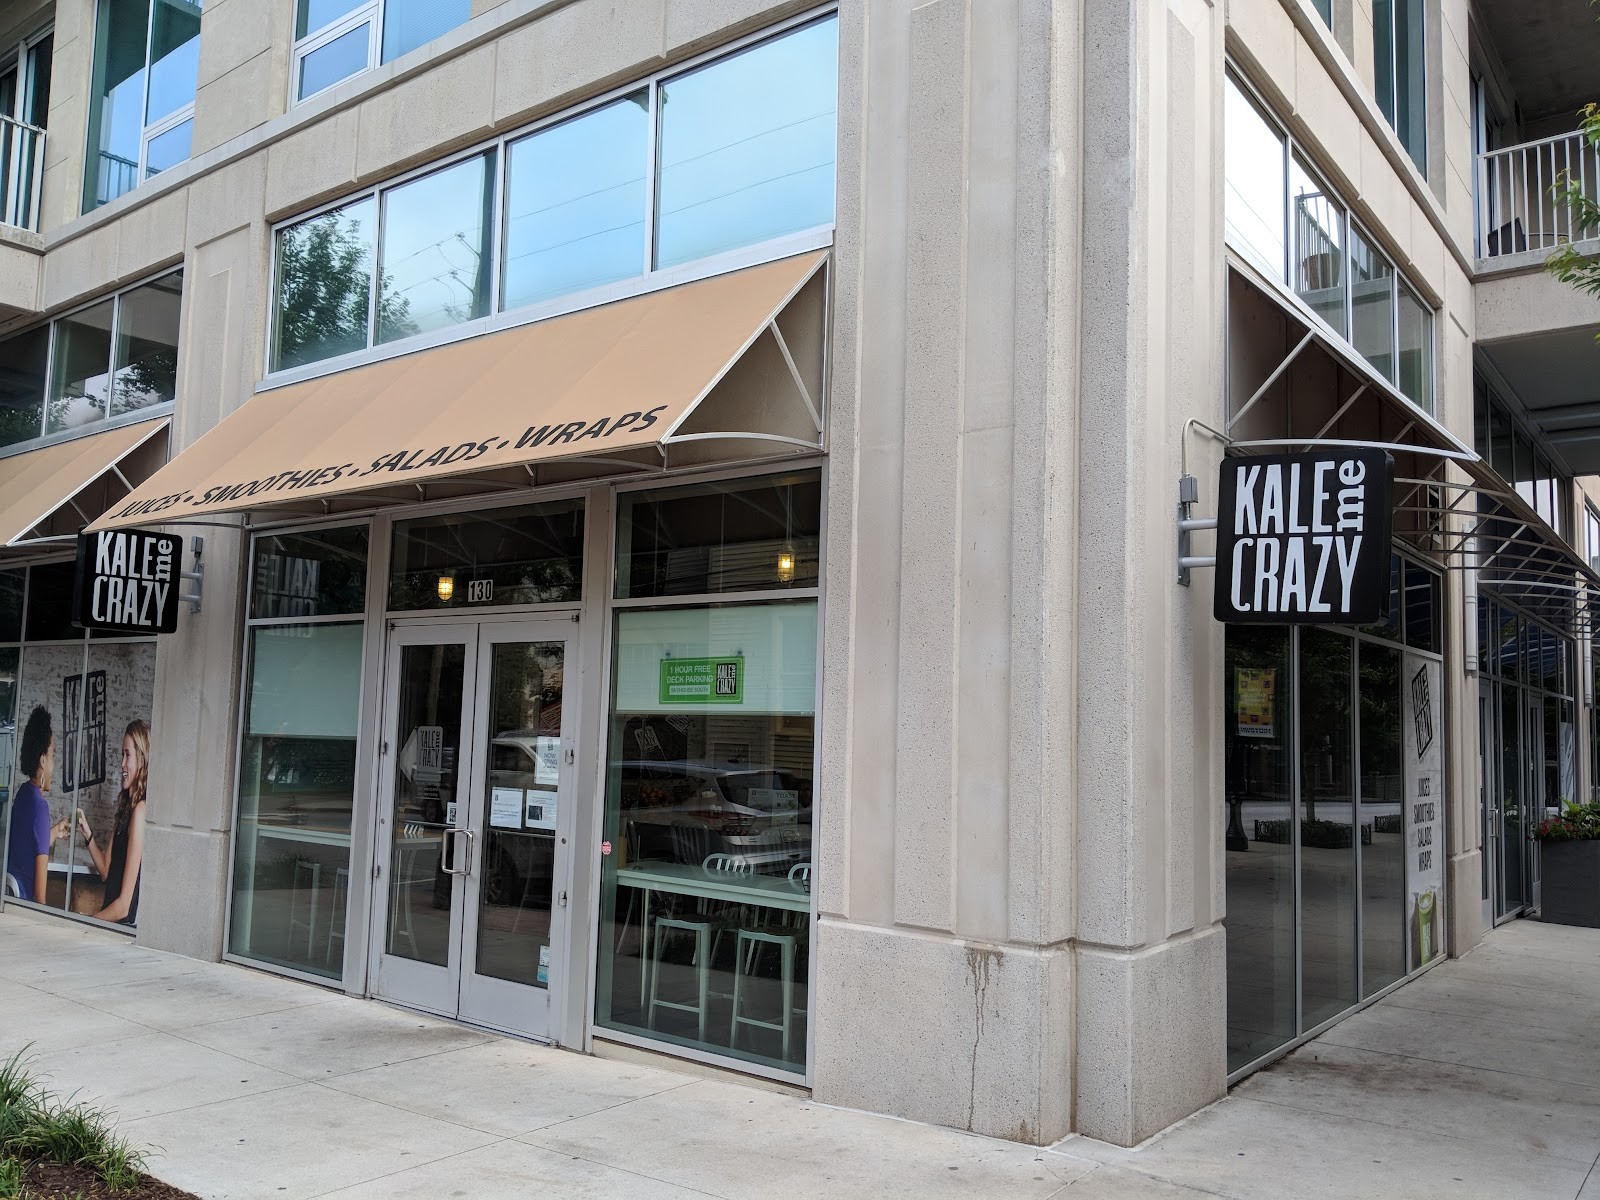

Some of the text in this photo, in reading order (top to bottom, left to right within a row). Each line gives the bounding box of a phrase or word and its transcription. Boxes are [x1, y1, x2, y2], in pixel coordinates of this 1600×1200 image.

[109, 405, 669, 519] JUICES SMOOTHIES SALADS WRAPS
[1235, 459, 1366, 535] KALE me
[95, 530, 174, 582] KALE me
[470, 580, 492, 600] 130
[1231, 536, 1363, 613] CRAZY
[92, 575, 170, 627] CRAZY
[666, 674, 714, 684] DECK PARKING
[675, 665, 693, 673] HOUR
[694, 664, 711, 673] FREE
[717, 664, 732, 679] KALE
[717, 678, 736, 694] CRAZY
